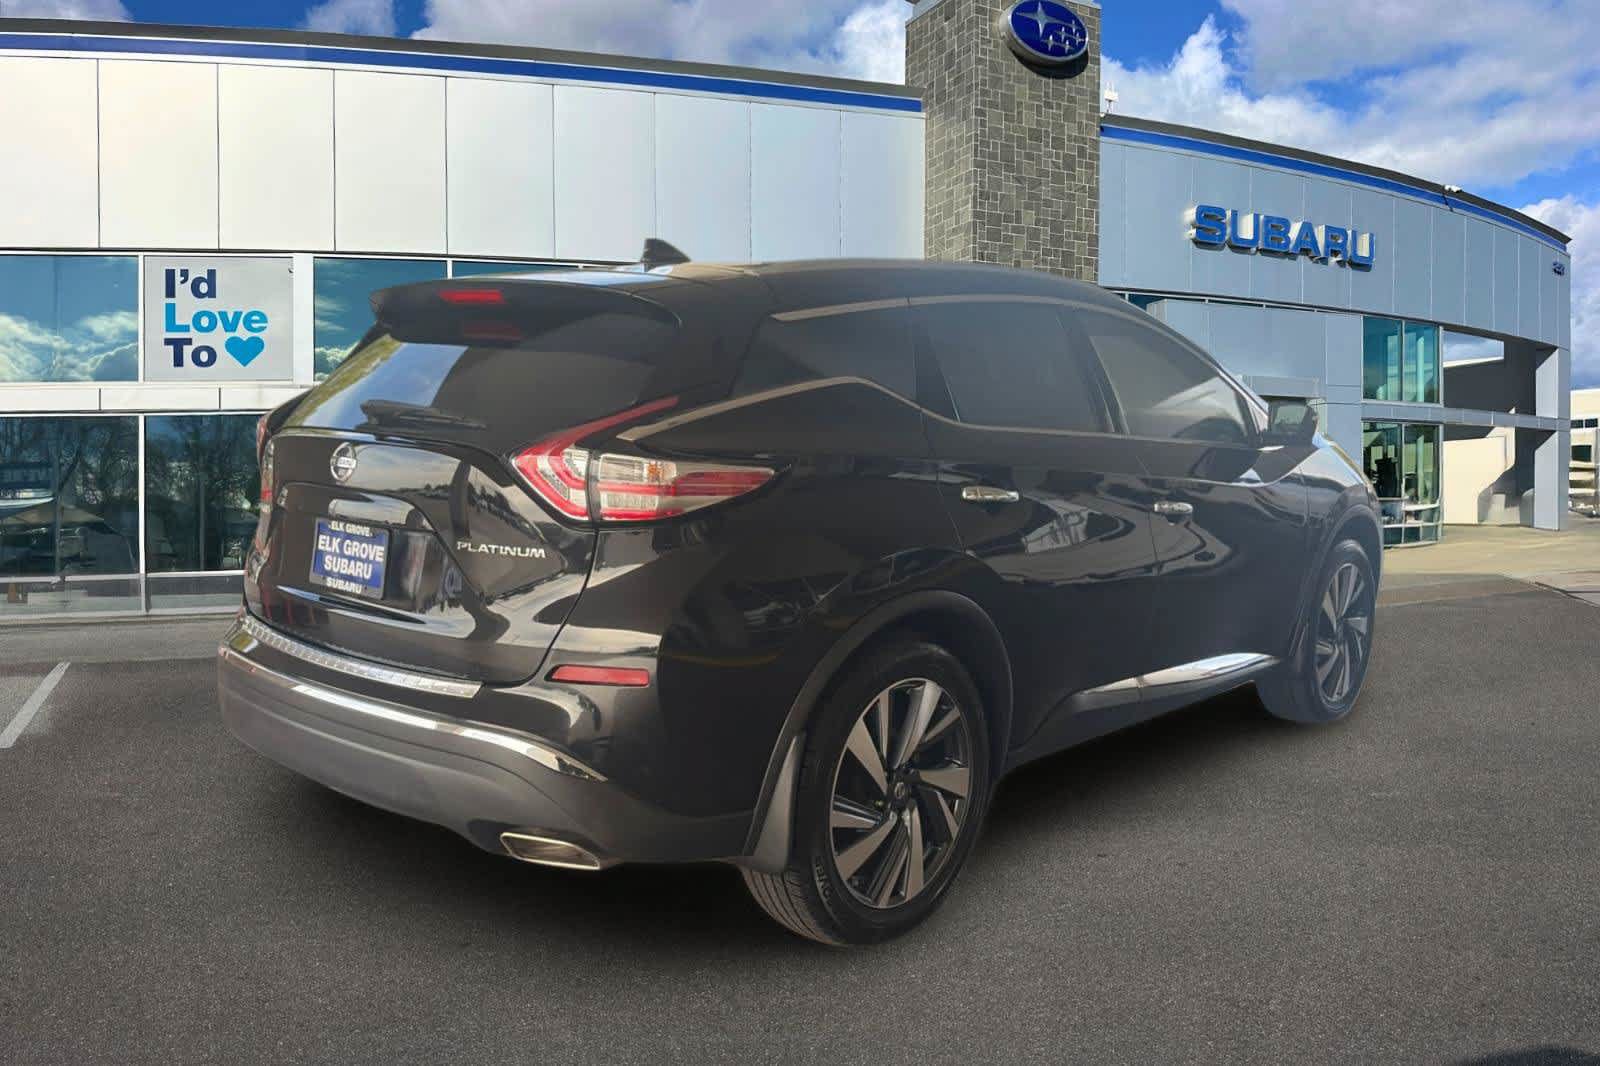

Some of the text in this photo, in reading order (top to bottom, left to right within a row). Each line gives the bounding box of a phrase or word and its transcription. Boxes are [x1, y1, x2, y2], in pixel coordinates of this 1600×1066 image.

[1193, 204, 1376, 268] SUBARU
[165, 268, 217, 299] I’d
[165, 302, 268, 333] Love
[164, 337, 217, 368] To
[331, 521, 371, 537] ELK GROVE
[318, 534, 385, 562] ELK GROVE
[456, 541, 547, 559] PLATINUM
[324, 554, 373, 579] SUBARU
[326, 577, 363, 594] SUBARU
